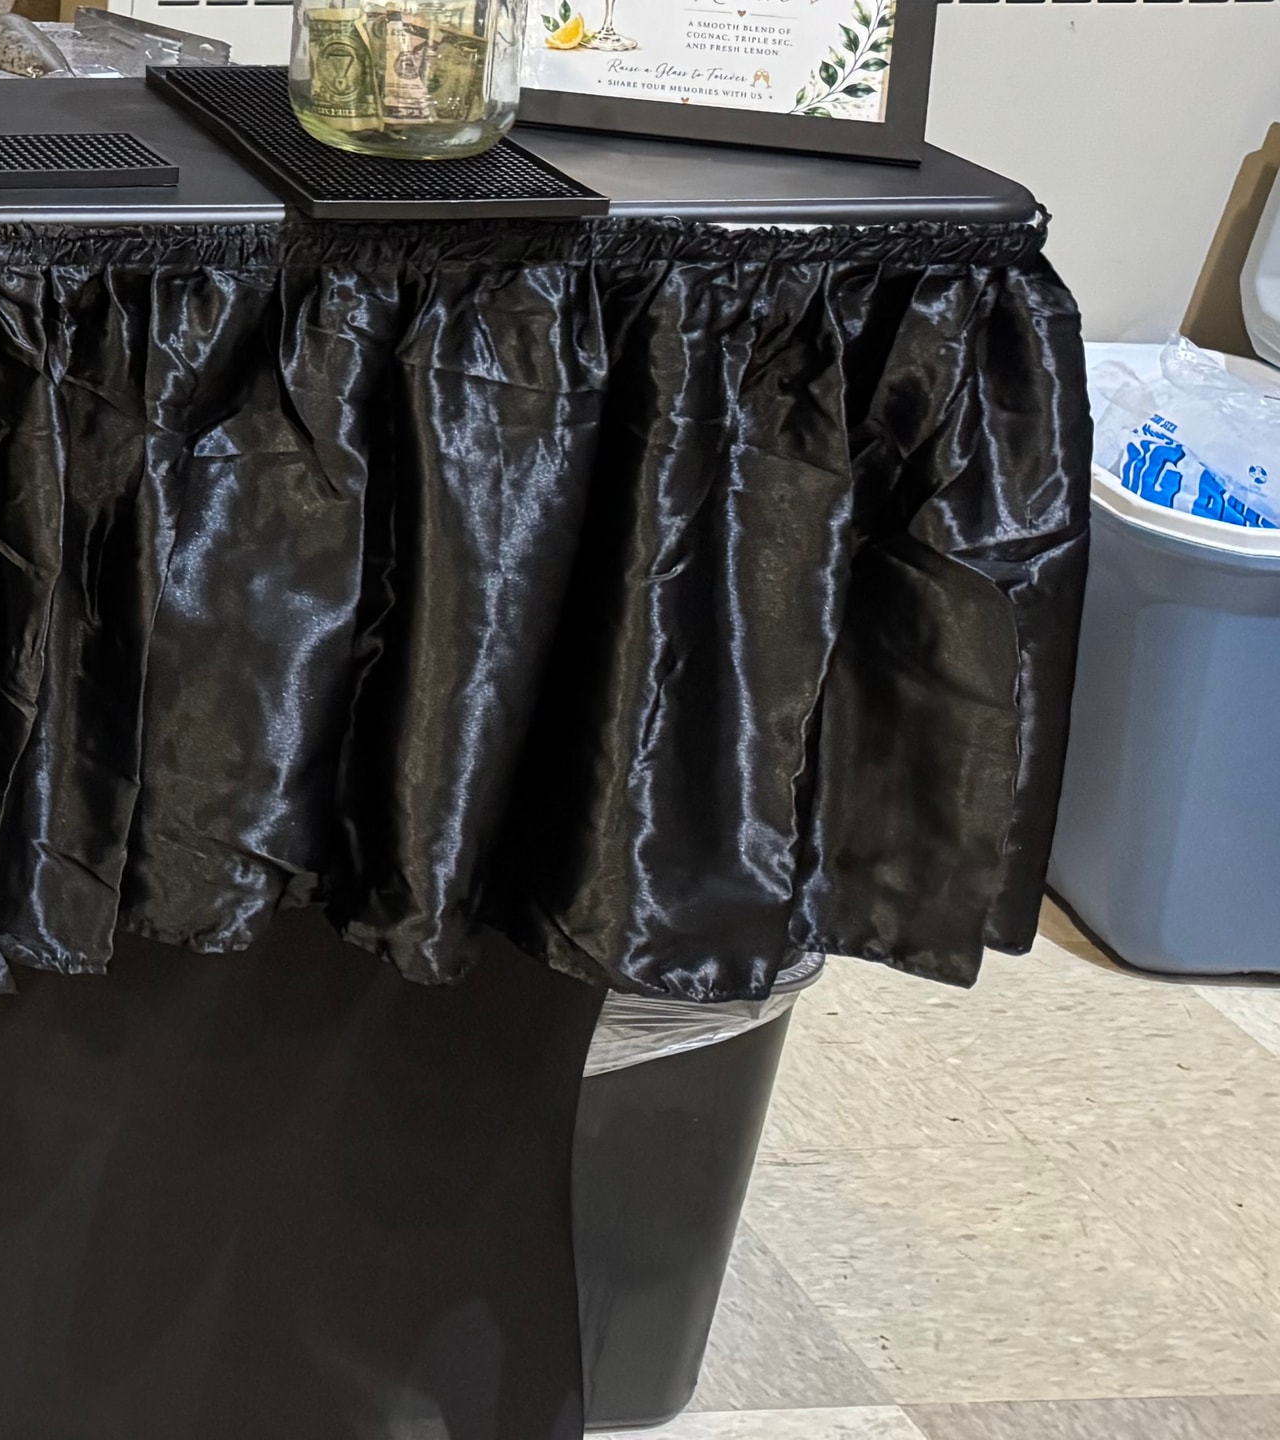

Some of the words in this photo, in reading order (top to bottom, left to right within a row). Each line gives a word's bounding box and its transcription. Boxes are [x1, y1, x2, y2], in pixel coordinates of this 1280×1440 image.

[697, 21, 739, 31] SMOOTH
[743, 25, 775, 34] BLEND
[735, 36, 769, 44] TRIPLE
[686, 42, 706, 50] AND
[710, 44, 740, 53] FRESH
[655, 62, 689, 78] Glass
[706, 67, 747, 82] Forever
[608, 79, 638, 88] SHARE
[641, 82, 666, 91] YOUR
[669, 85, 719, 96] MEMORIES
[722, 90, 747, 98] WITH
[751, 92, 763, 100] US
